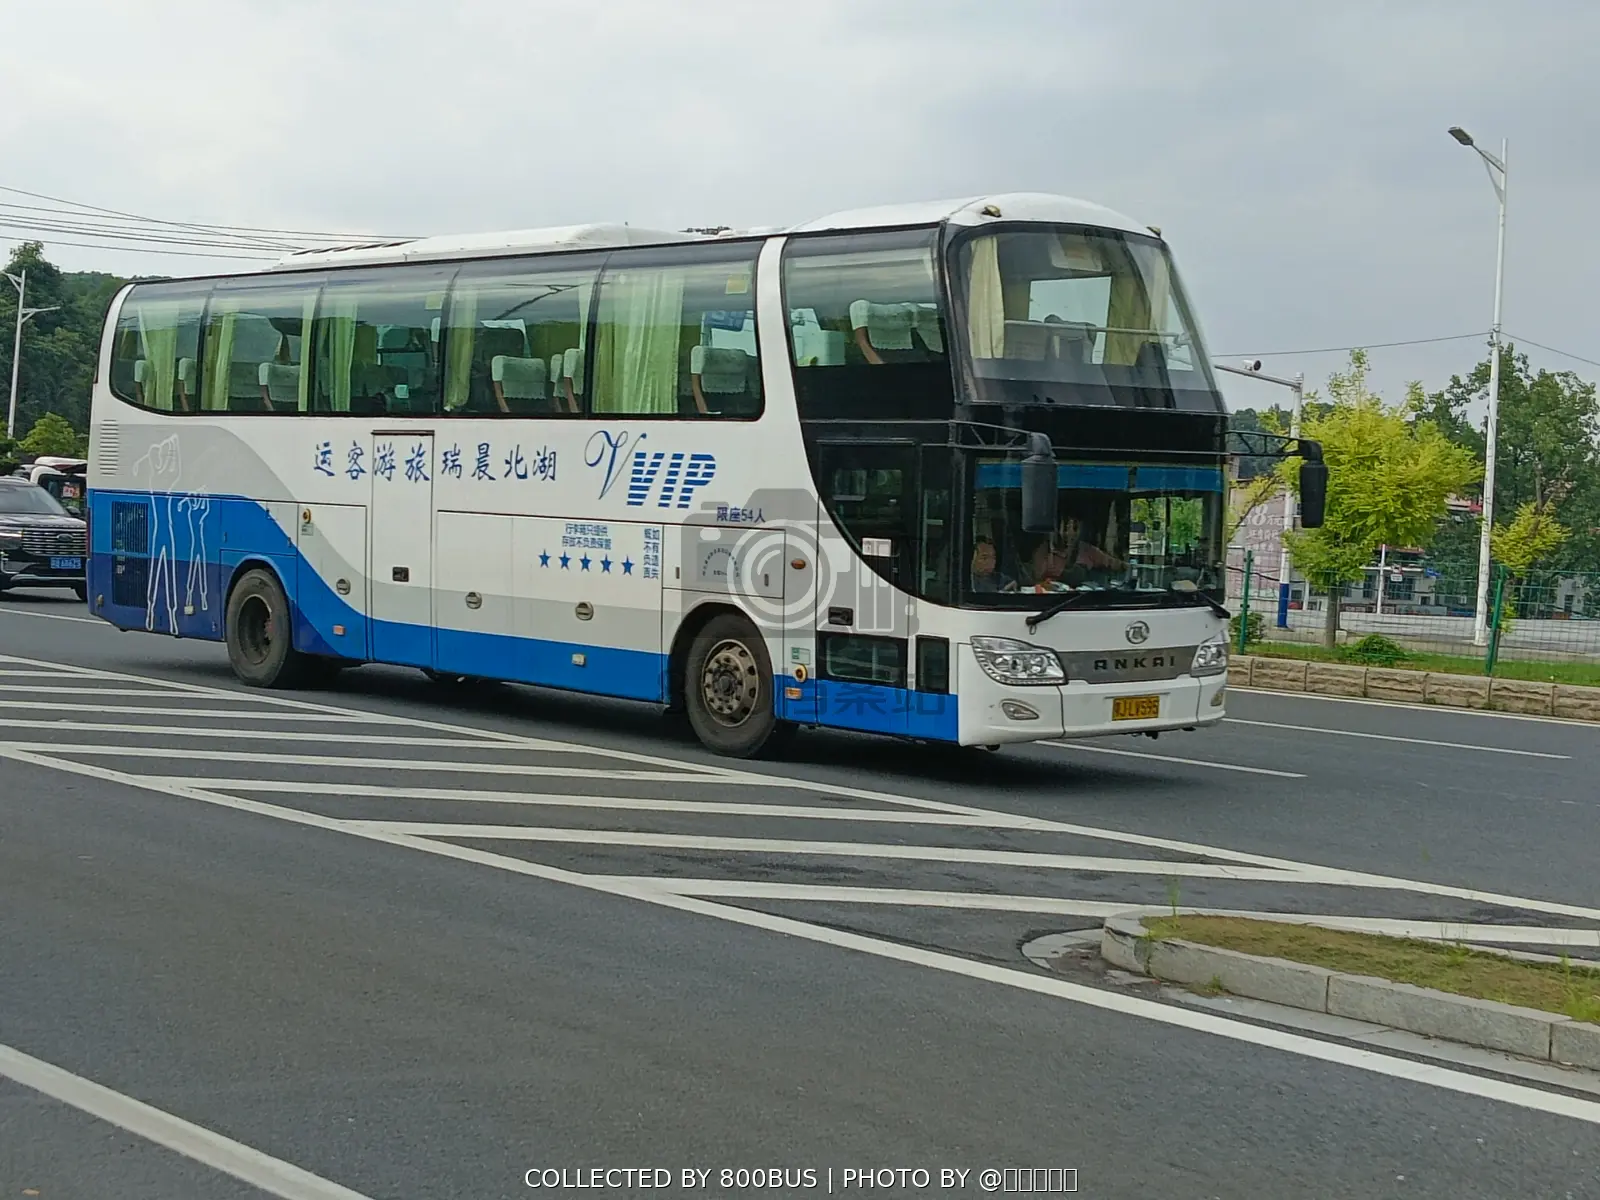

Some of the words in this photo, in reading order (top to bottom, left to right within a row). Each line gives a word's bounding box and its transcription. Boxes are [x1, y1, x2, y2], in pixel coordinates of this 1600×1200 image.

[627, 452, 717, 509] VIP
[716, 506, 766, 523] 限座54人
[1093, 656, 1176, 671] ANKAI
